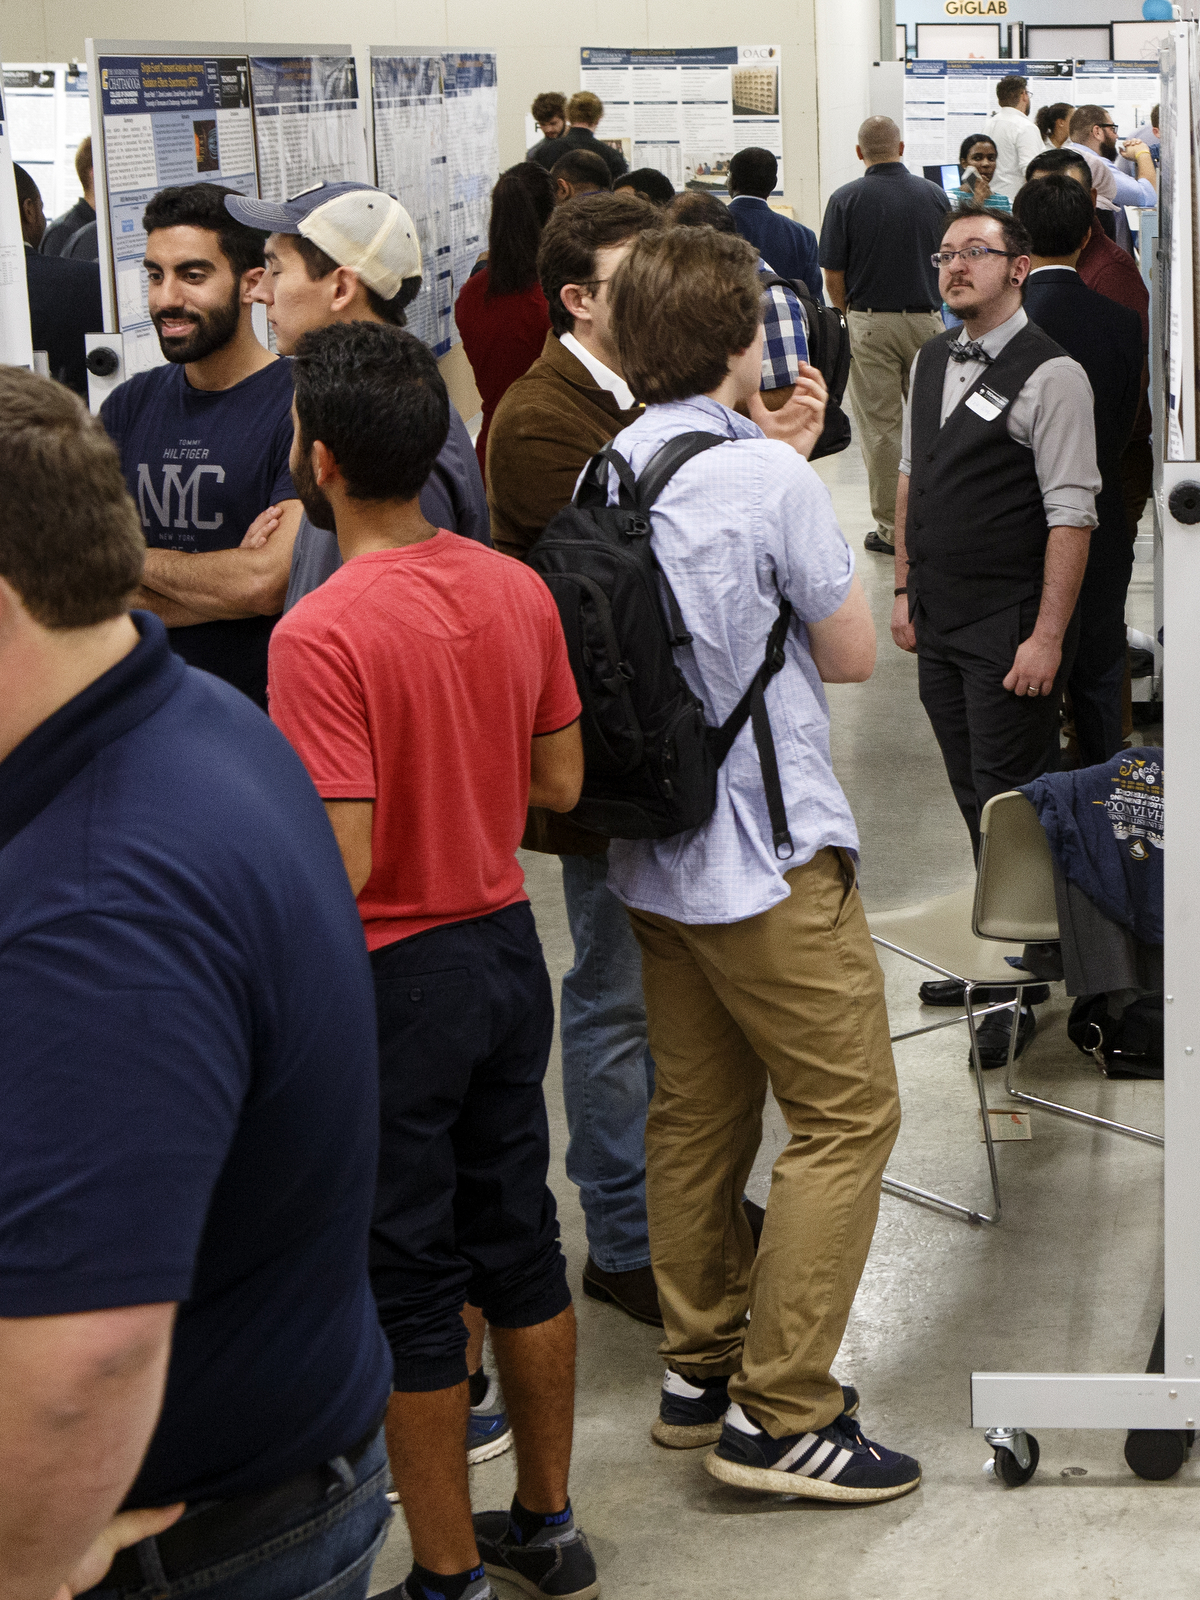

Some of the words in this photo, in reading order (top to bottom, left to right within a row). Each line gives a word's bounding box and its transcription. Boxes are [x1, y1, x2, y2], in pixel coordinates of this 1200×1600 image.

[945, 1, 1008, 15] GiGLAB
[162, 448, 210, 460] HILFIGER
[137, 463, 226, 531] NYC
[159, 533, 174, 541] NEW
[178, 533, 196, 543] YORK
